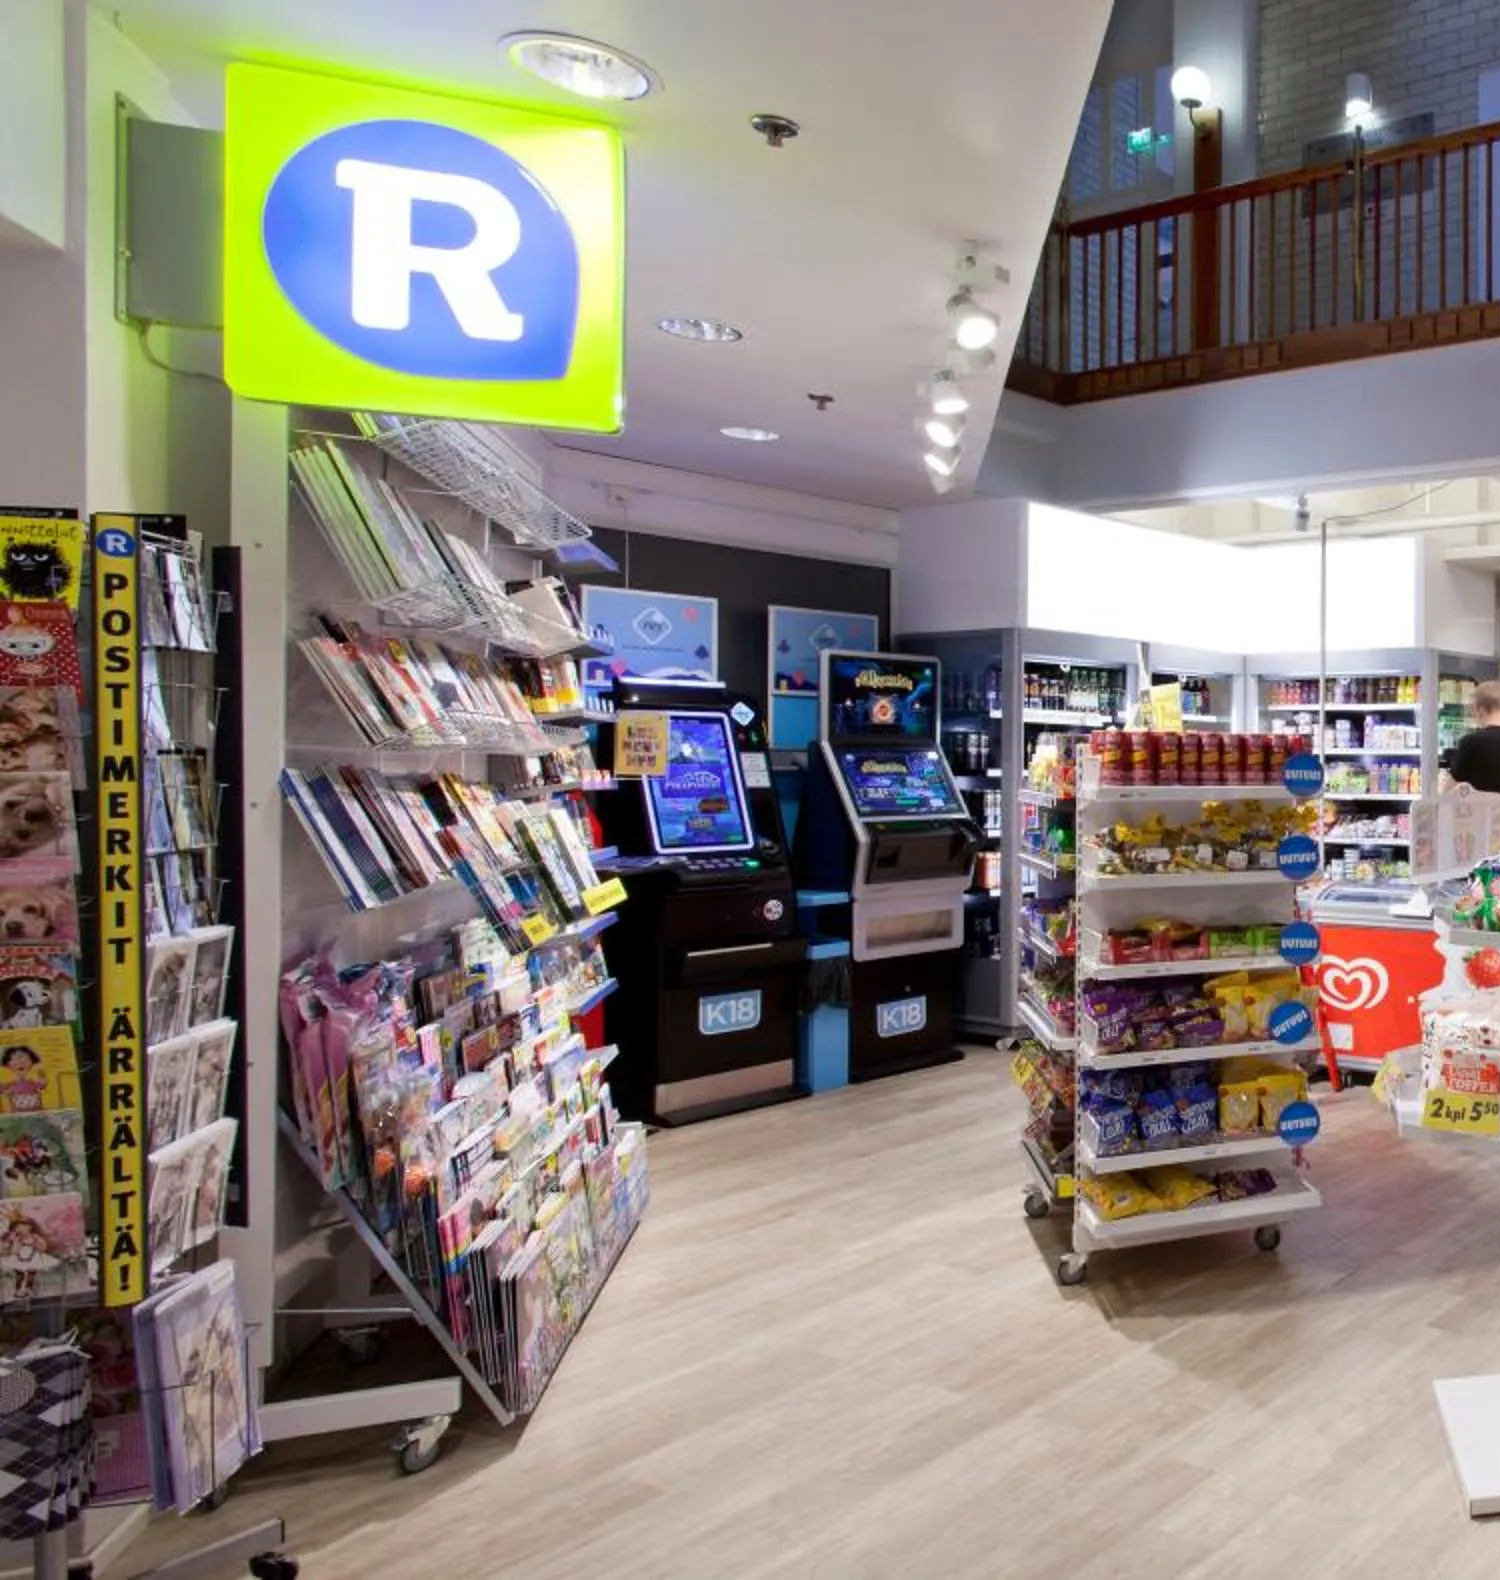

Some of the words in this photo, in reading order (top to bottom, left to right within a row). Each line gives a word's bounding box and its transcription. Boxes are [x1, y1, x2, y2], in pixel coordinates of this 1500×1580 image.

[335, 157, 524, 342] R
[105, 533, 128, 555] R
[705, 998, 754, 1028] K18
[882, 1003, 922, 1030] K18
[106, 1007, 138, 1292] ÄRRÄLTÄ!
